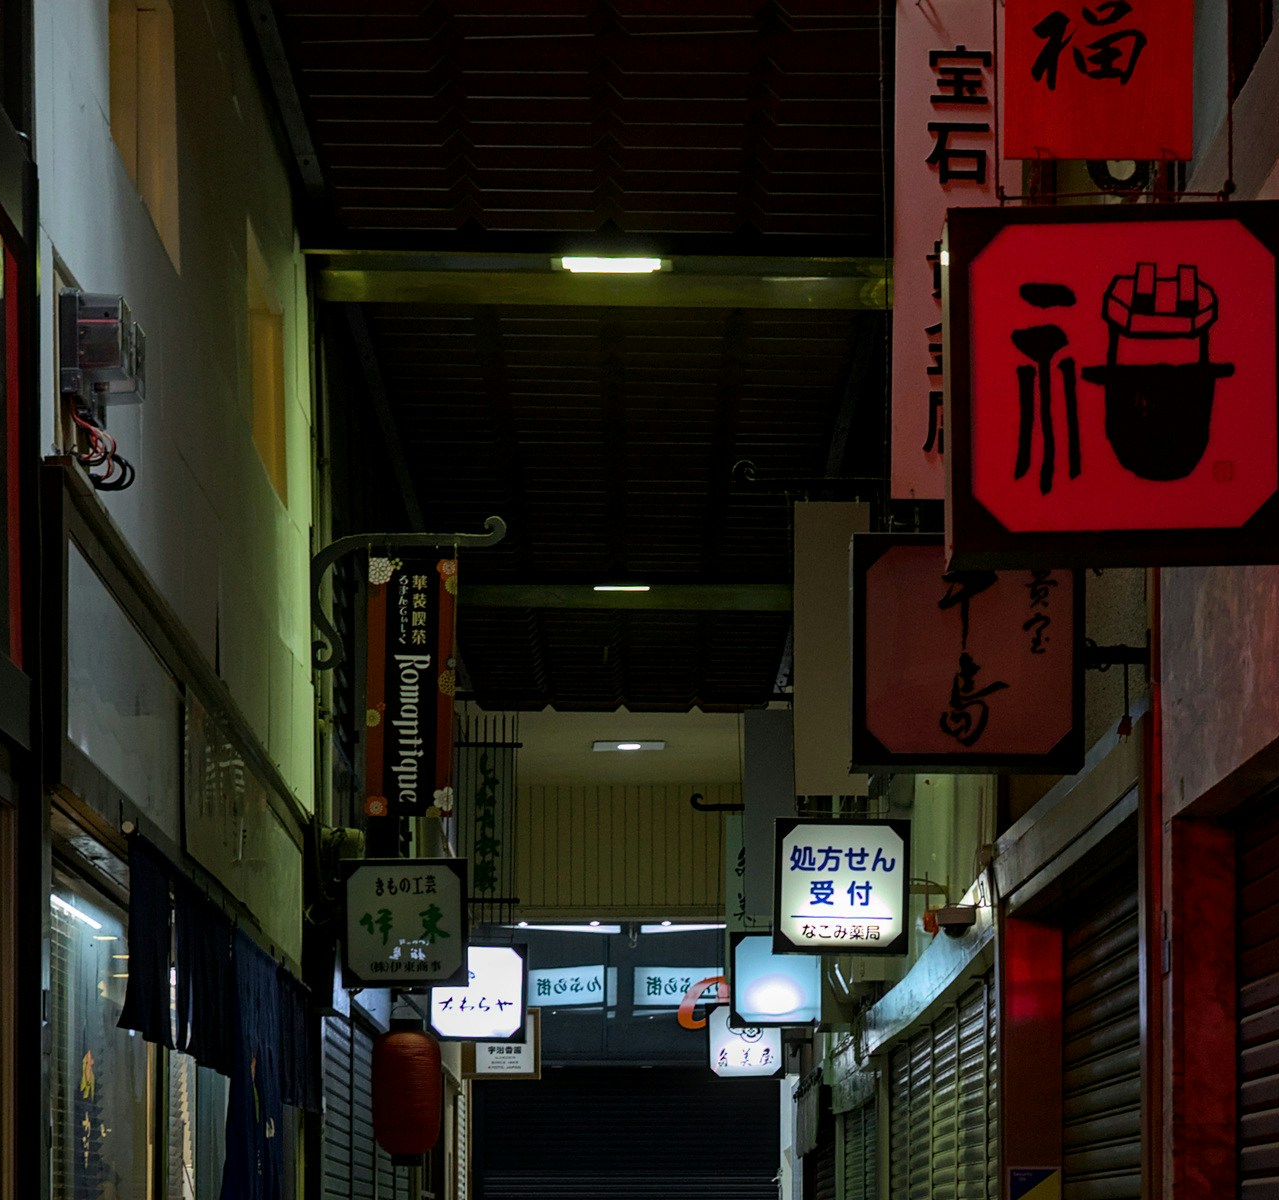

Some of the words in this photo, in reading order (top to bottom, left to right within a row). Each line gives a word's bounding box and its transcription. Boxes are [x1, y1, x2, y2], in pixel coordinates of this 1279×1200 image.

[1031, 0, 1148, 91] 福
[925, 45, 992, 185] 宝石
[391, 654, 432, 804] Romantique
[375, 875, 438, 897] きもの工芸
[789, 845, 896, 873] 処方せん
[809, 880, 873, 907] 受付
